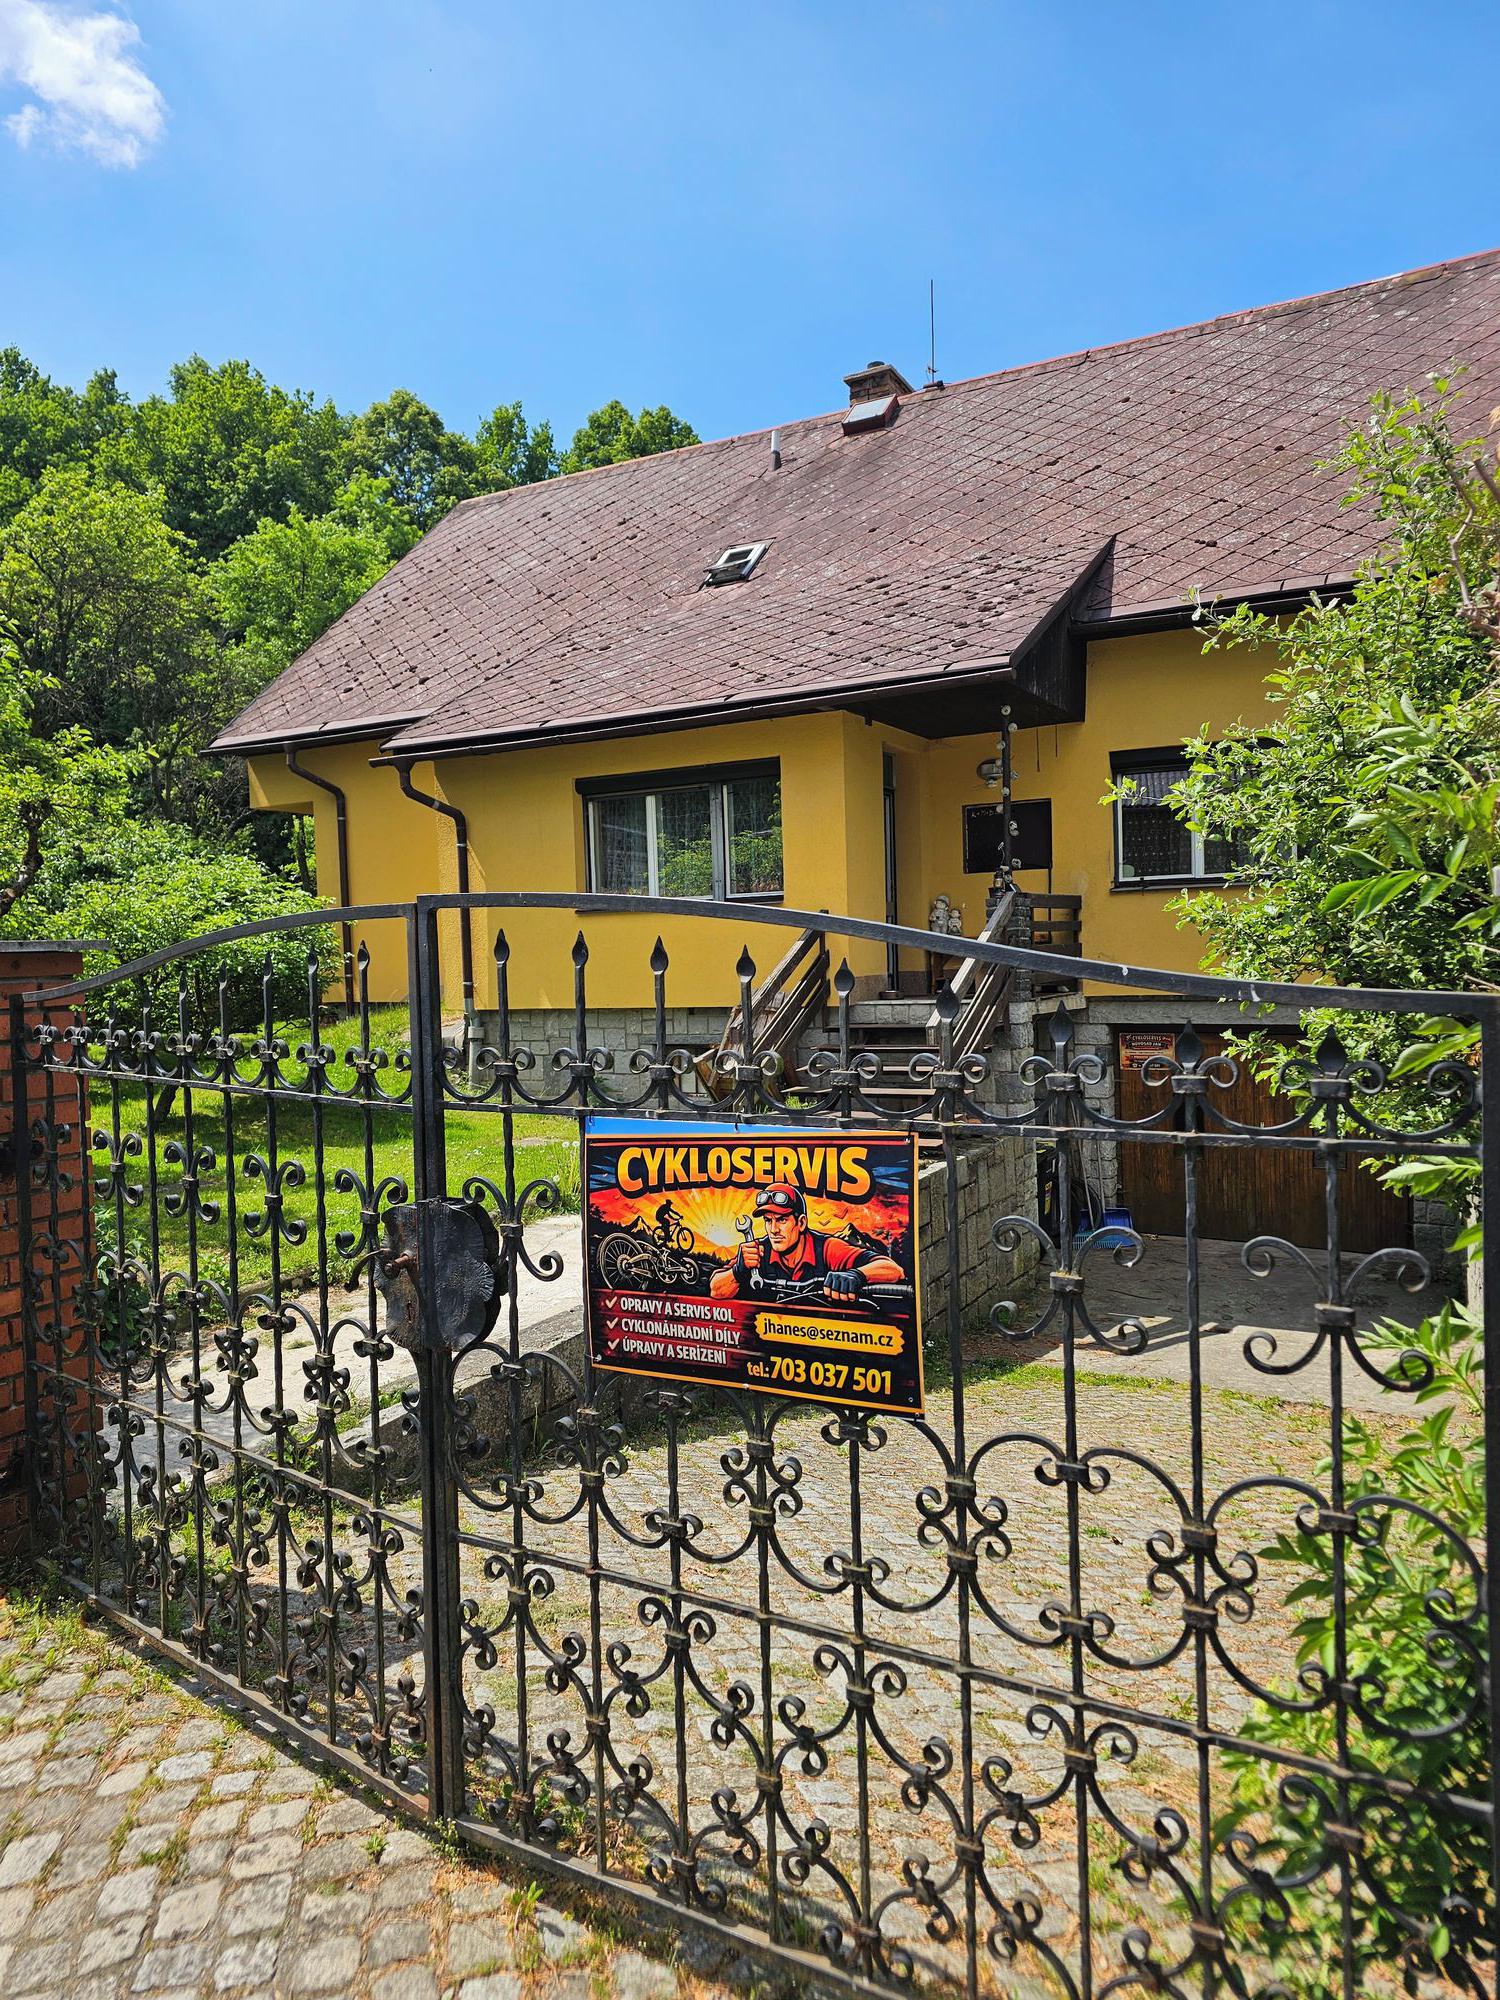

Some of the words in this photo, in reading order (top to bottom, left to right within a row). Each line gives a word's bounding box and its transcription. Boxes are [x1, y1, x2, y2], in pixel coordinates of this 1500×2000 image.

[617, 1147, 871, 1197] CYKLOSERVIS
[620, 1297, 662, 1315] OPRAVY
[664, 1301, 673, 1316] A
[674, 1303, 711, 1320] SERVIS
[712, 1306, 735, 1323] KOL
[715, 1327, 741, 1345] DÍLY
[763, 1318, 893, 1347] jhanes@seznam.cz
[667, 1343, 675, 1358] A
[746, 1361, 770, 1378] tel.:
[770, 1356, 806, 1383] 703
[810, 1361, 849, 1388] 037
[852, 1367, 892, 1395] 501
